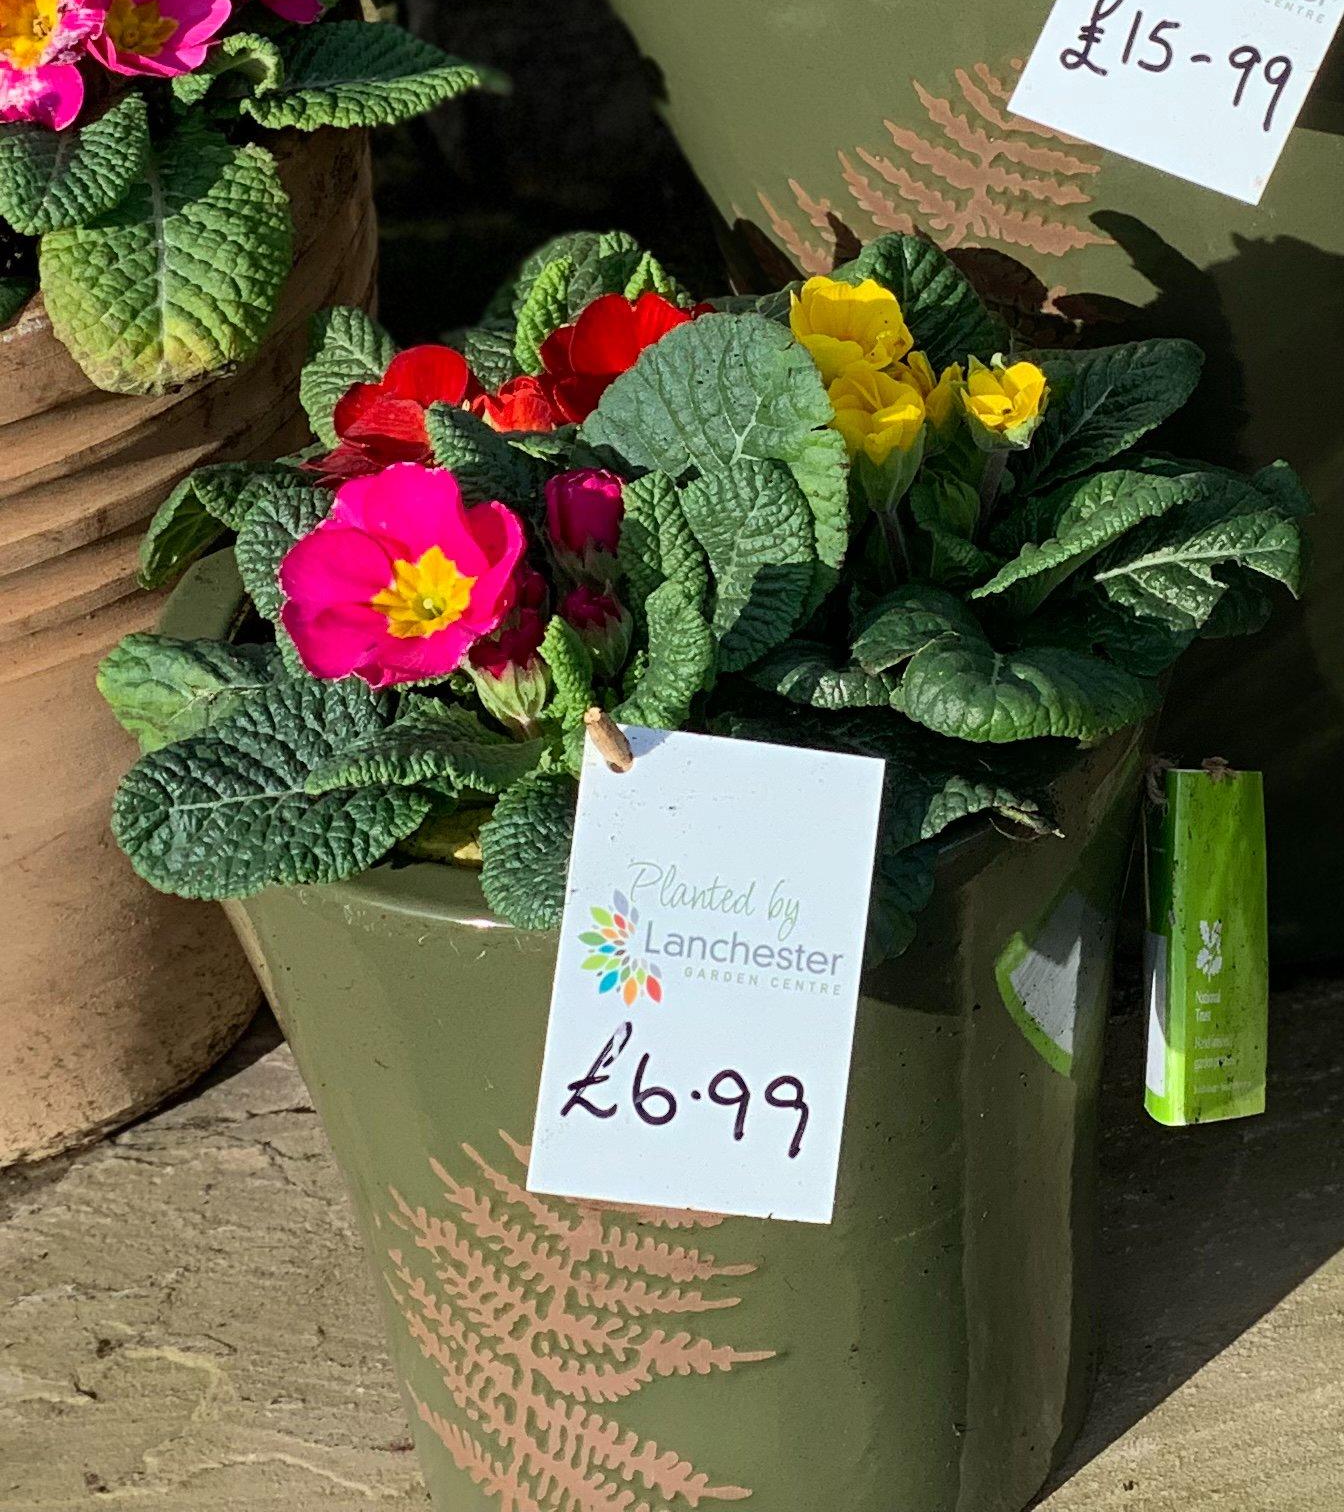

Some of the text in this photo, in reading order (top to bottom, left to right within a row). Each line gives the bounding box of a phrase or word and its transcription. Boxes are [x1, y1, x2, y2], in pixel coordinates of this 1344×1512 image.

[627, 861, 800, 941] Planted by
[645, 920, 844, 976] Lanchester
[684, 966, 842, 996] GARDEN CENTRE
